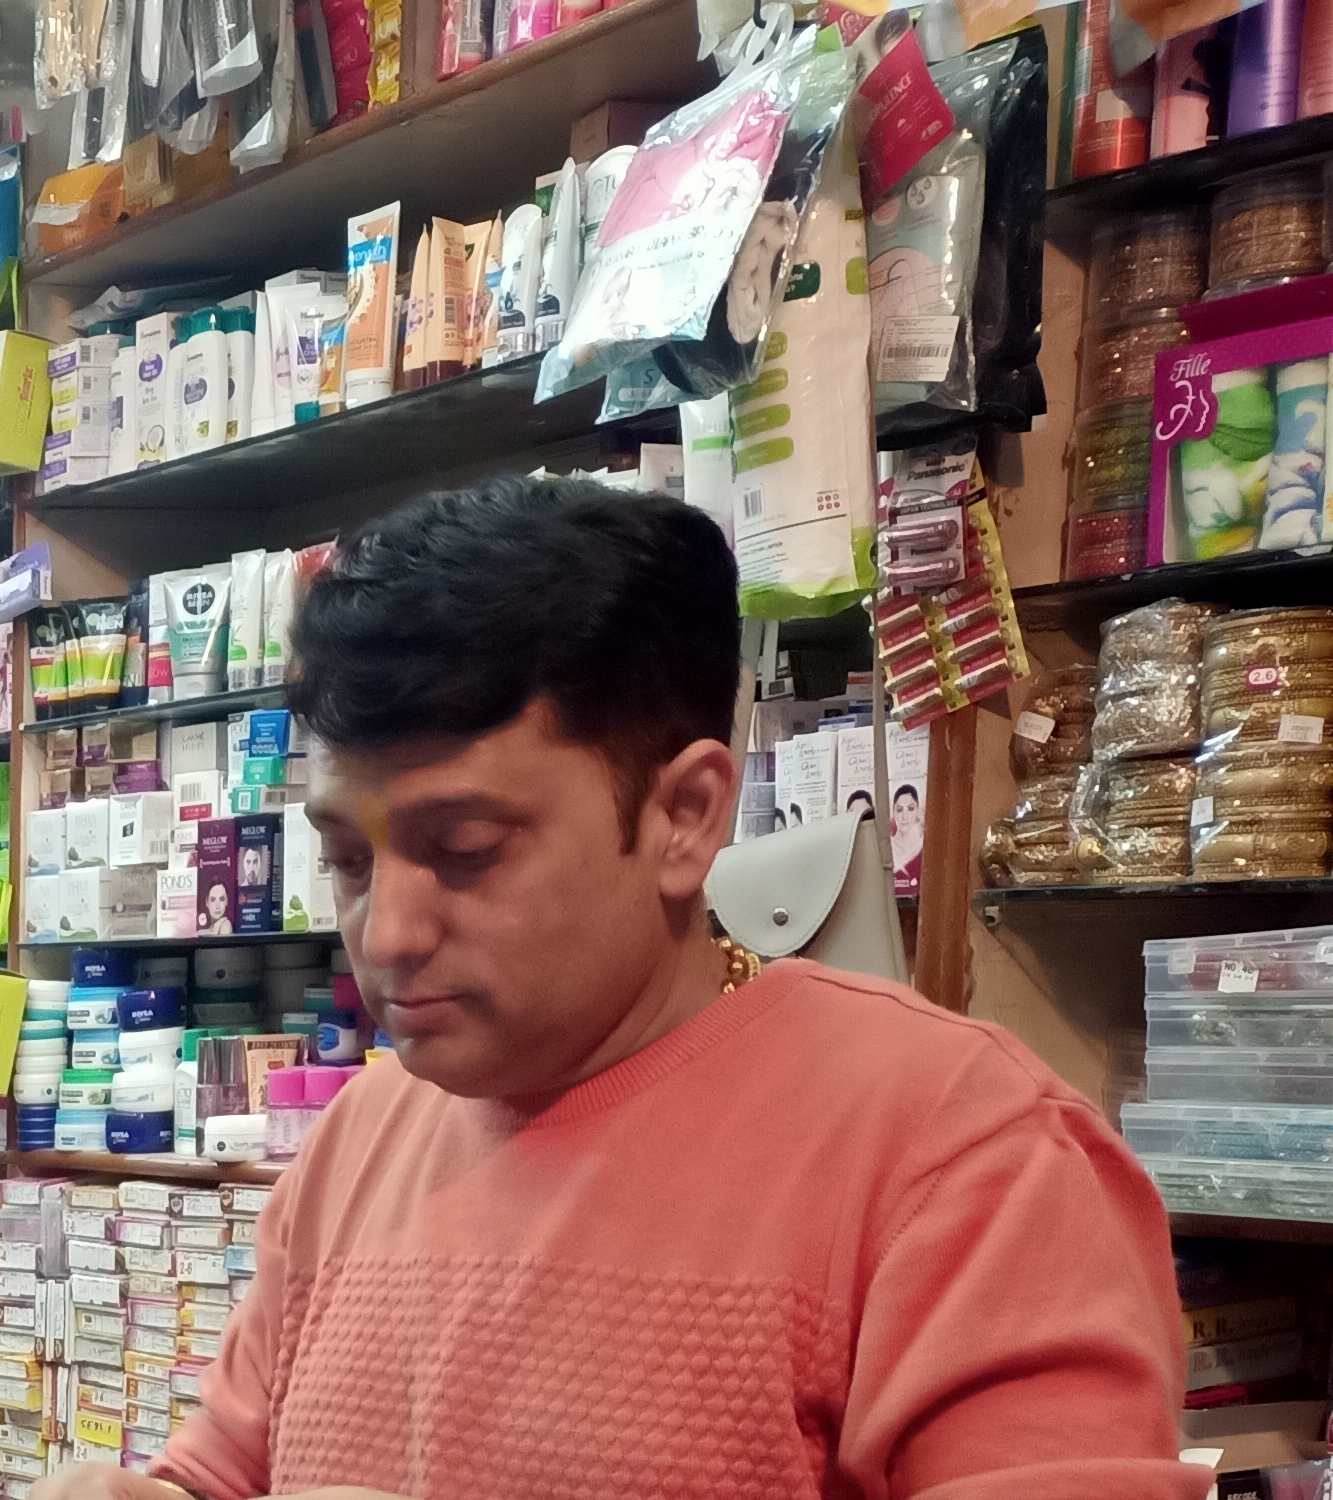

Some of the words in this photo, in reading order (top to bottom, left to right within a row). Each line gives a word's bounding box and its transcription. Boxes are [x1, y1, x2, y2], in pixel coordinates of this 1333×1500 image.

[1170, 352, 1211, 381] Fille
[907, 461, 967, 482] Panasonic
[1252, 670, 1275, 682] 2.6
[161, 874, 193, 890] POND'S
[131, 1008, 153, 1018] NIVEA
